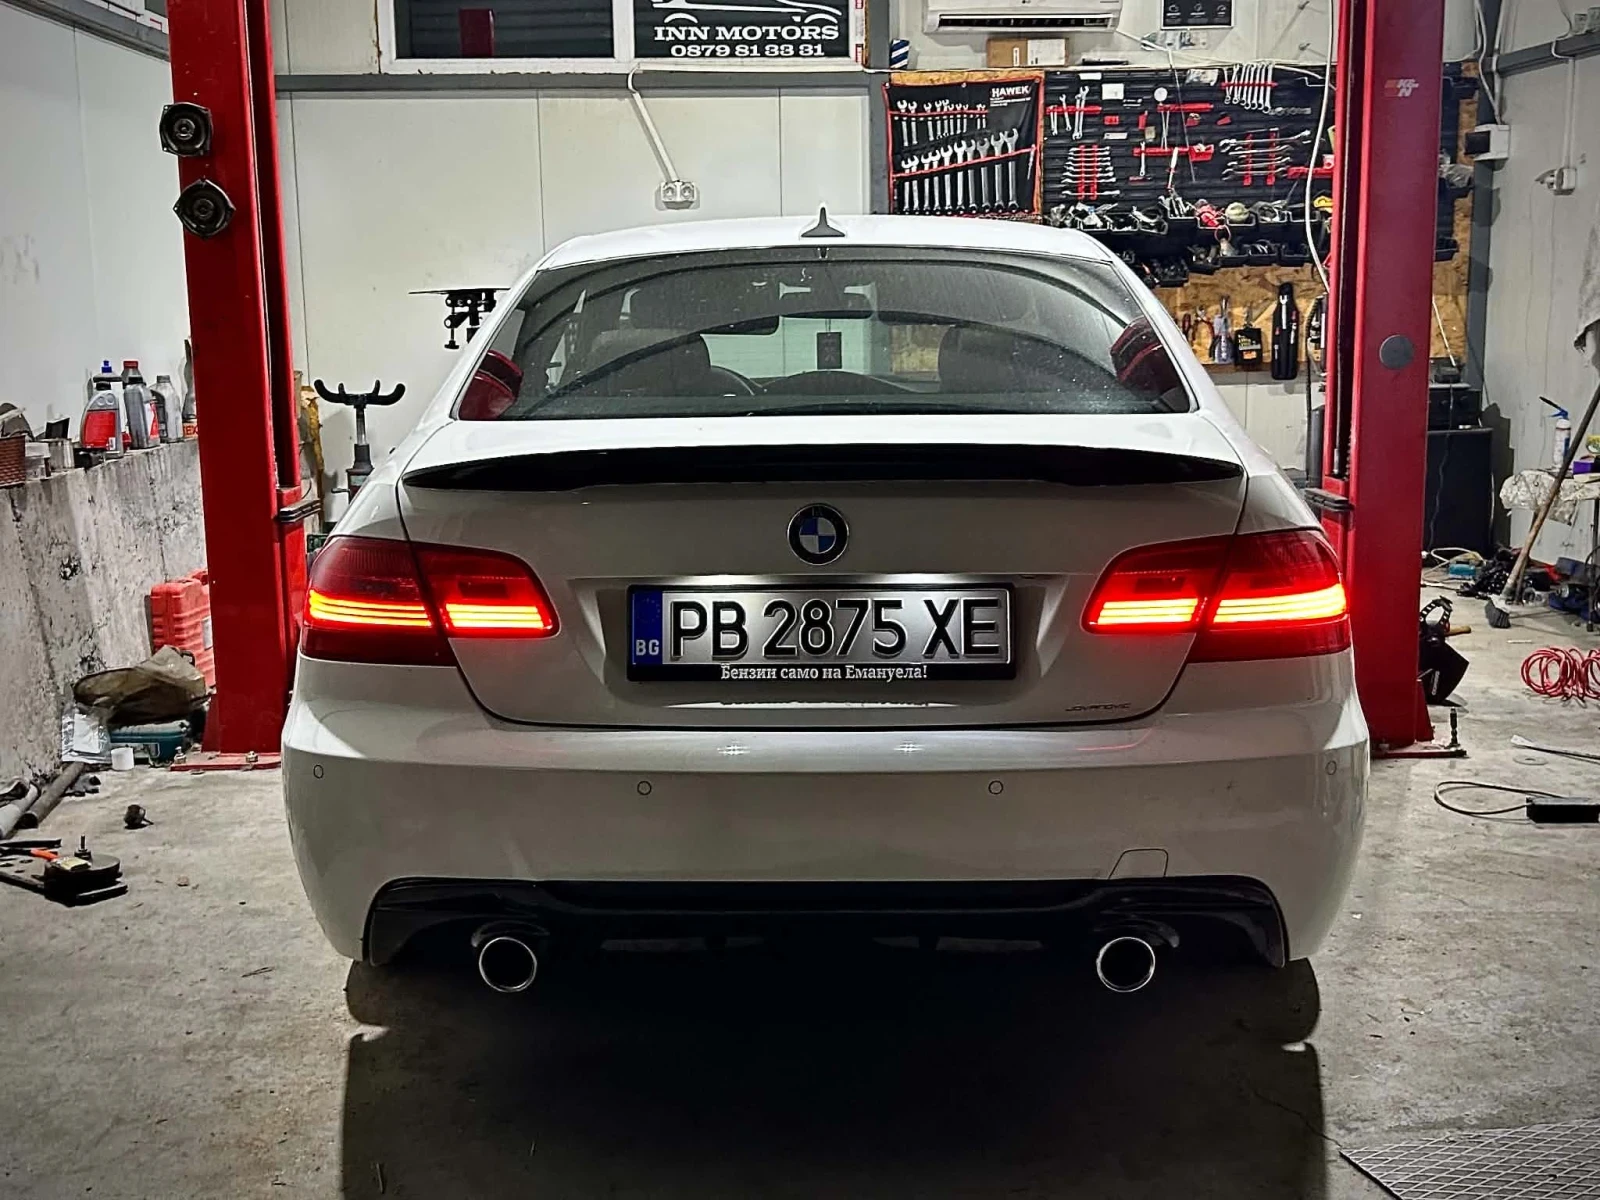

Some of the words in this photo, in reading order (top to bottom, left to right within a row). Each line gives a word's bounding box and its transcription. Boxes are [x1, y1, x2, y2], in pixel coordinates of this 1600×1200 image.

[654, 26, 710, 41] INN
[715, 25, 839, 40] MOTORS
[670, 44, 731, 57] 0879
[734, 44, 761, 57] 81
[764, 44, 795, 57] 33
[798, 44, 825, 57] 31
[991, 85, 1029, 97] HAWEK
[670, 600, 749, 661] PB
[762, 598, 907, 659] 2875
[922, 598, 1001, 659] XE
[635, 639, 660, 656] BG
[720, 663, 778, 680] Бензин
[780, 667, 819, 680] само
[822, 668, 842, 680] на
[844, 665, 928, 683] Емануела!
